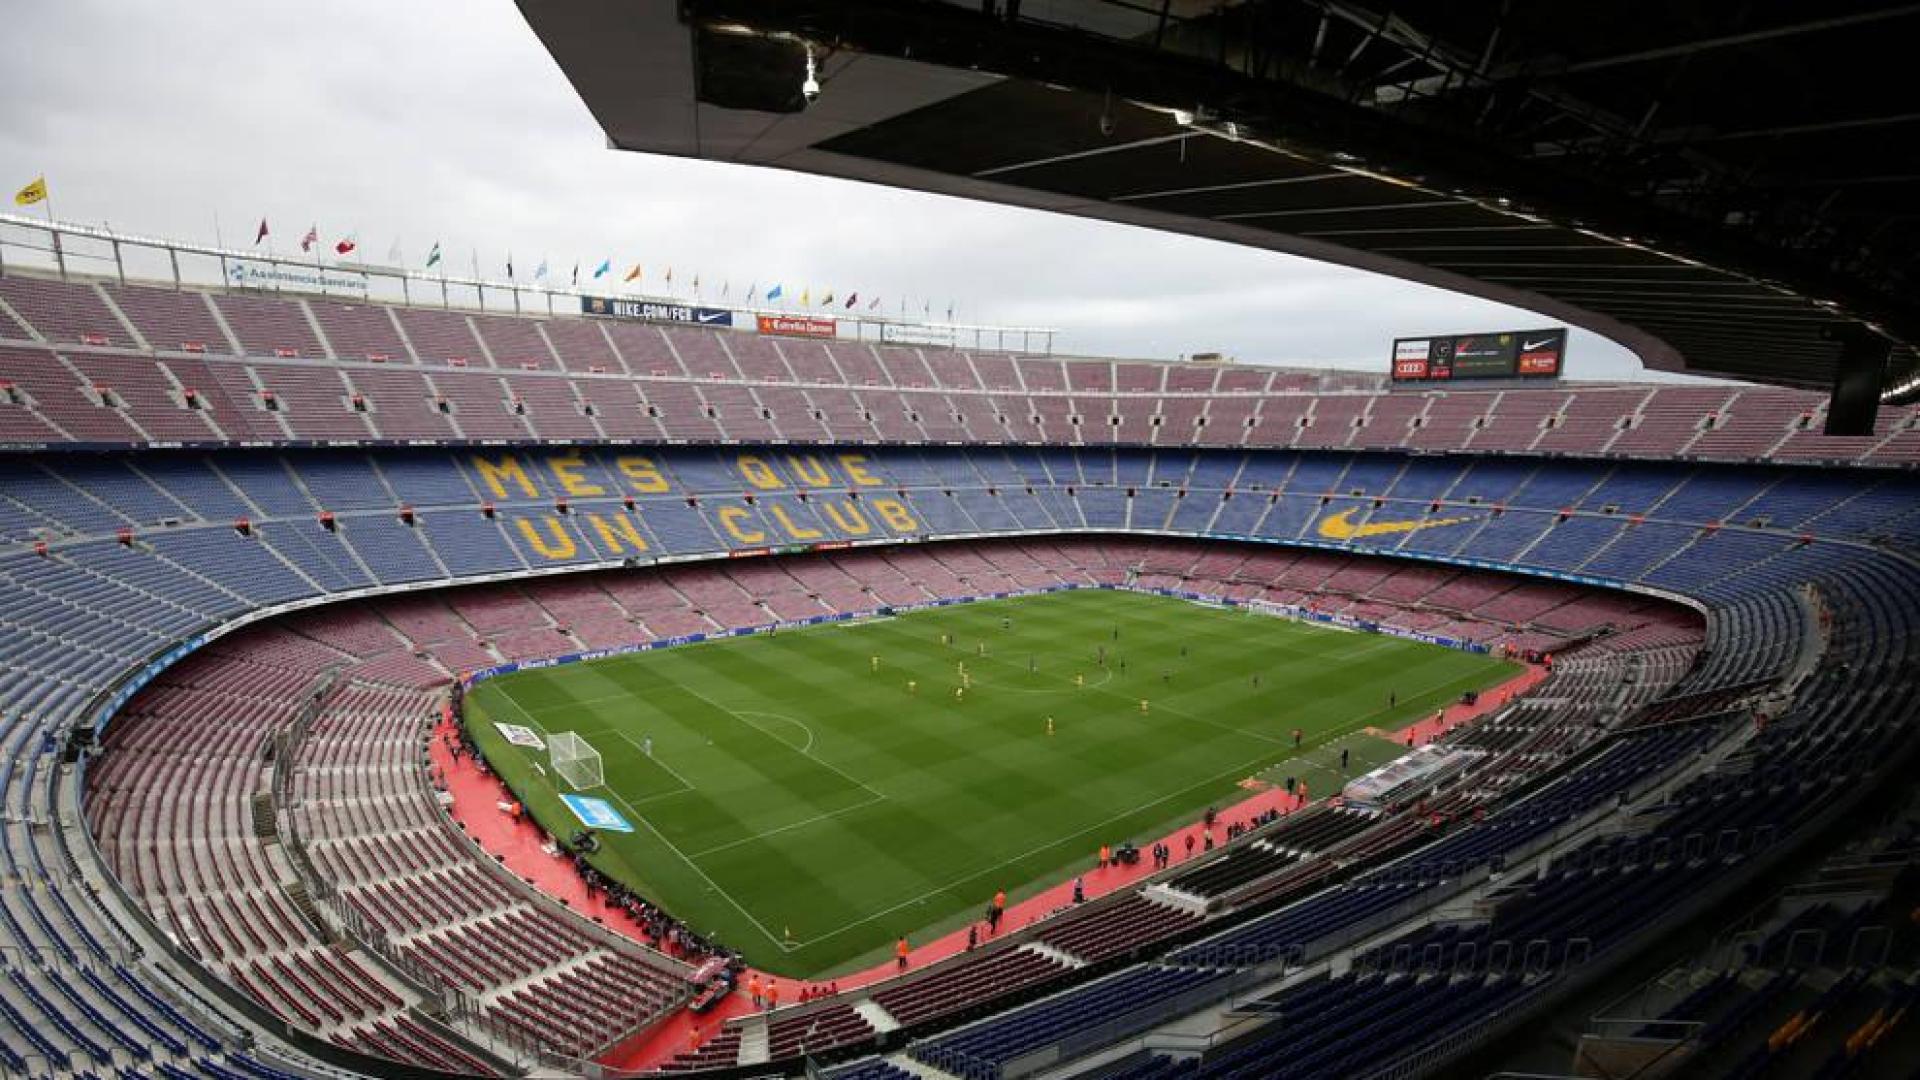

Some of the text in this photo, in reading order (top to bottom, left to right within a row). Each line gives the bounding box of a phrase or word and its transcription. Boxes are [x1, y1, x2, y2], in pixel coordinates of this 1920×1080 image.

[613, 301, 693, 321] NIKE.COM/FCB
[736, 454, 884, 490] QUE
[515, 499, 918, 560] UN CLUB
